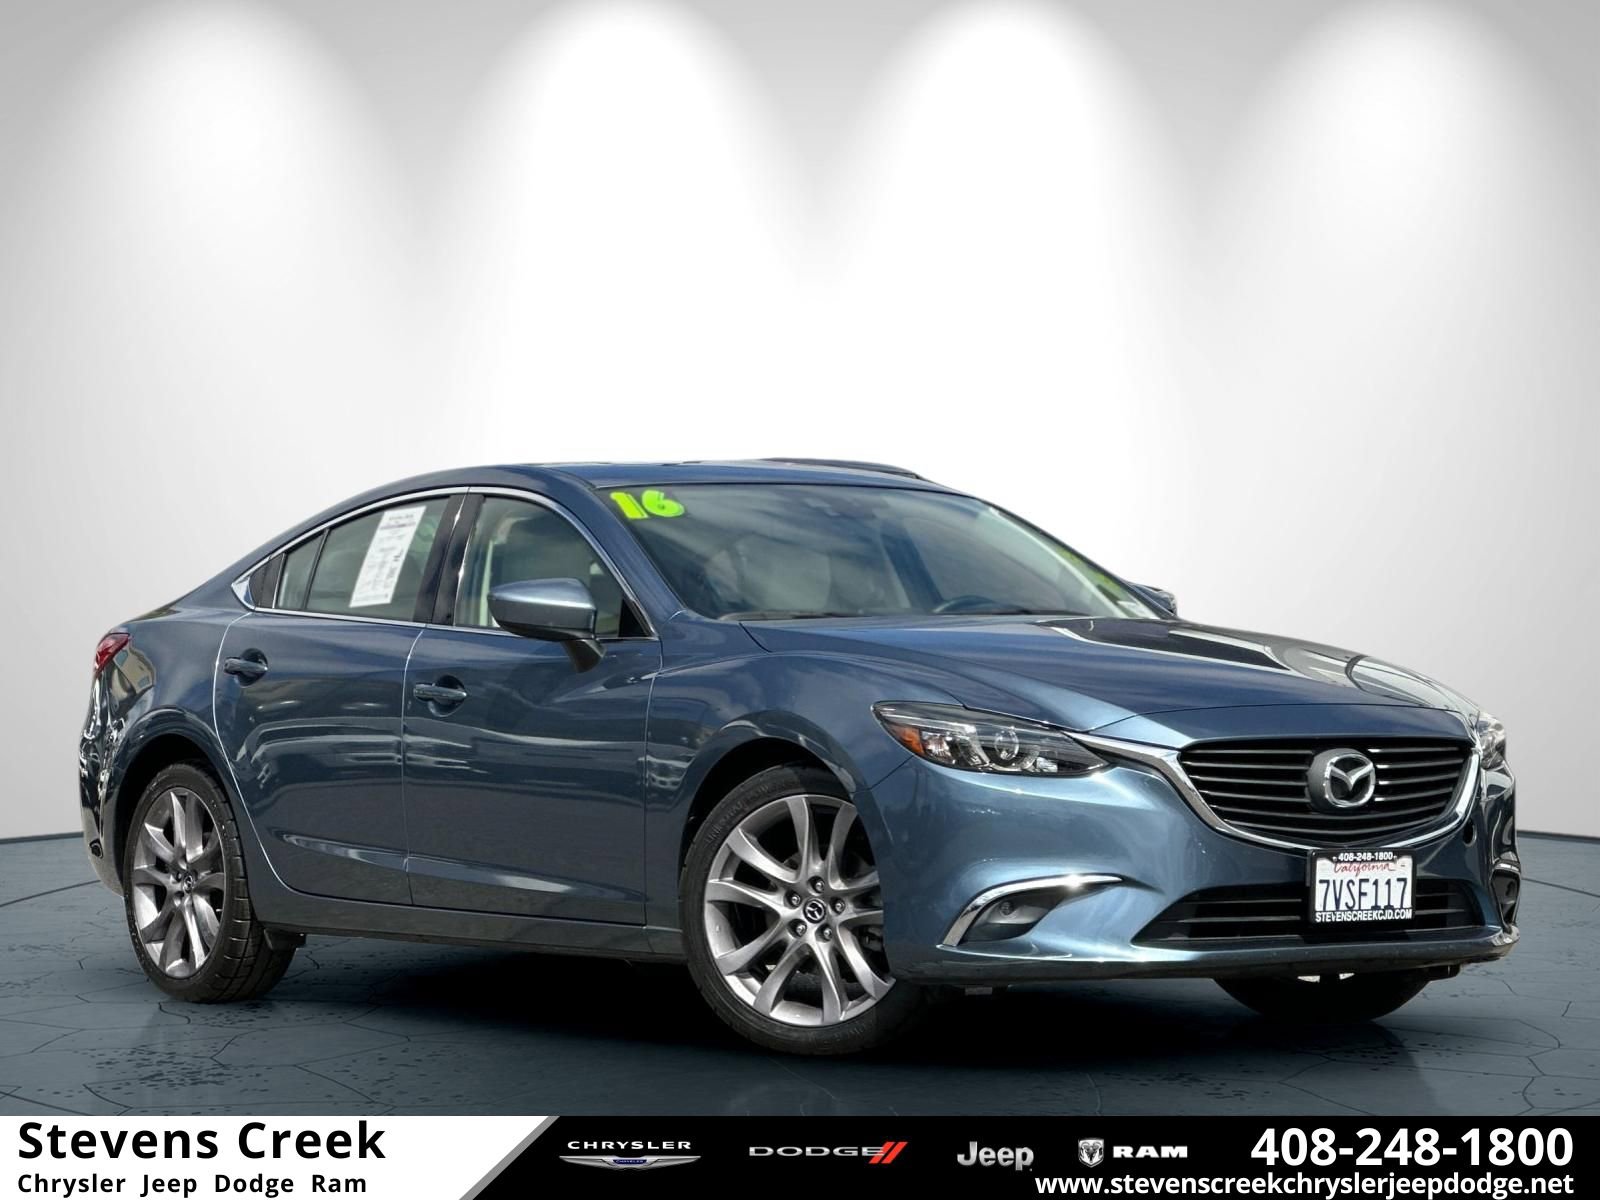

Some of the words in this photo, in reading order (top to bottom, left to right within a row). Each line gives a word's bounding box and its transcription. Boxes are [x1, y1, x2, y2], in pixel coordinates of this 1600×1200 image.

[610, 489, 685, 519] 16
[1338, 851, 1394, 861] 408-248-1800
[1333, 861, 1397, 877] California
[1318, 877, 1408, 911] 7VSF117
[1315, 908, 1413, 922] STEVENSCREEKCJD.COM
